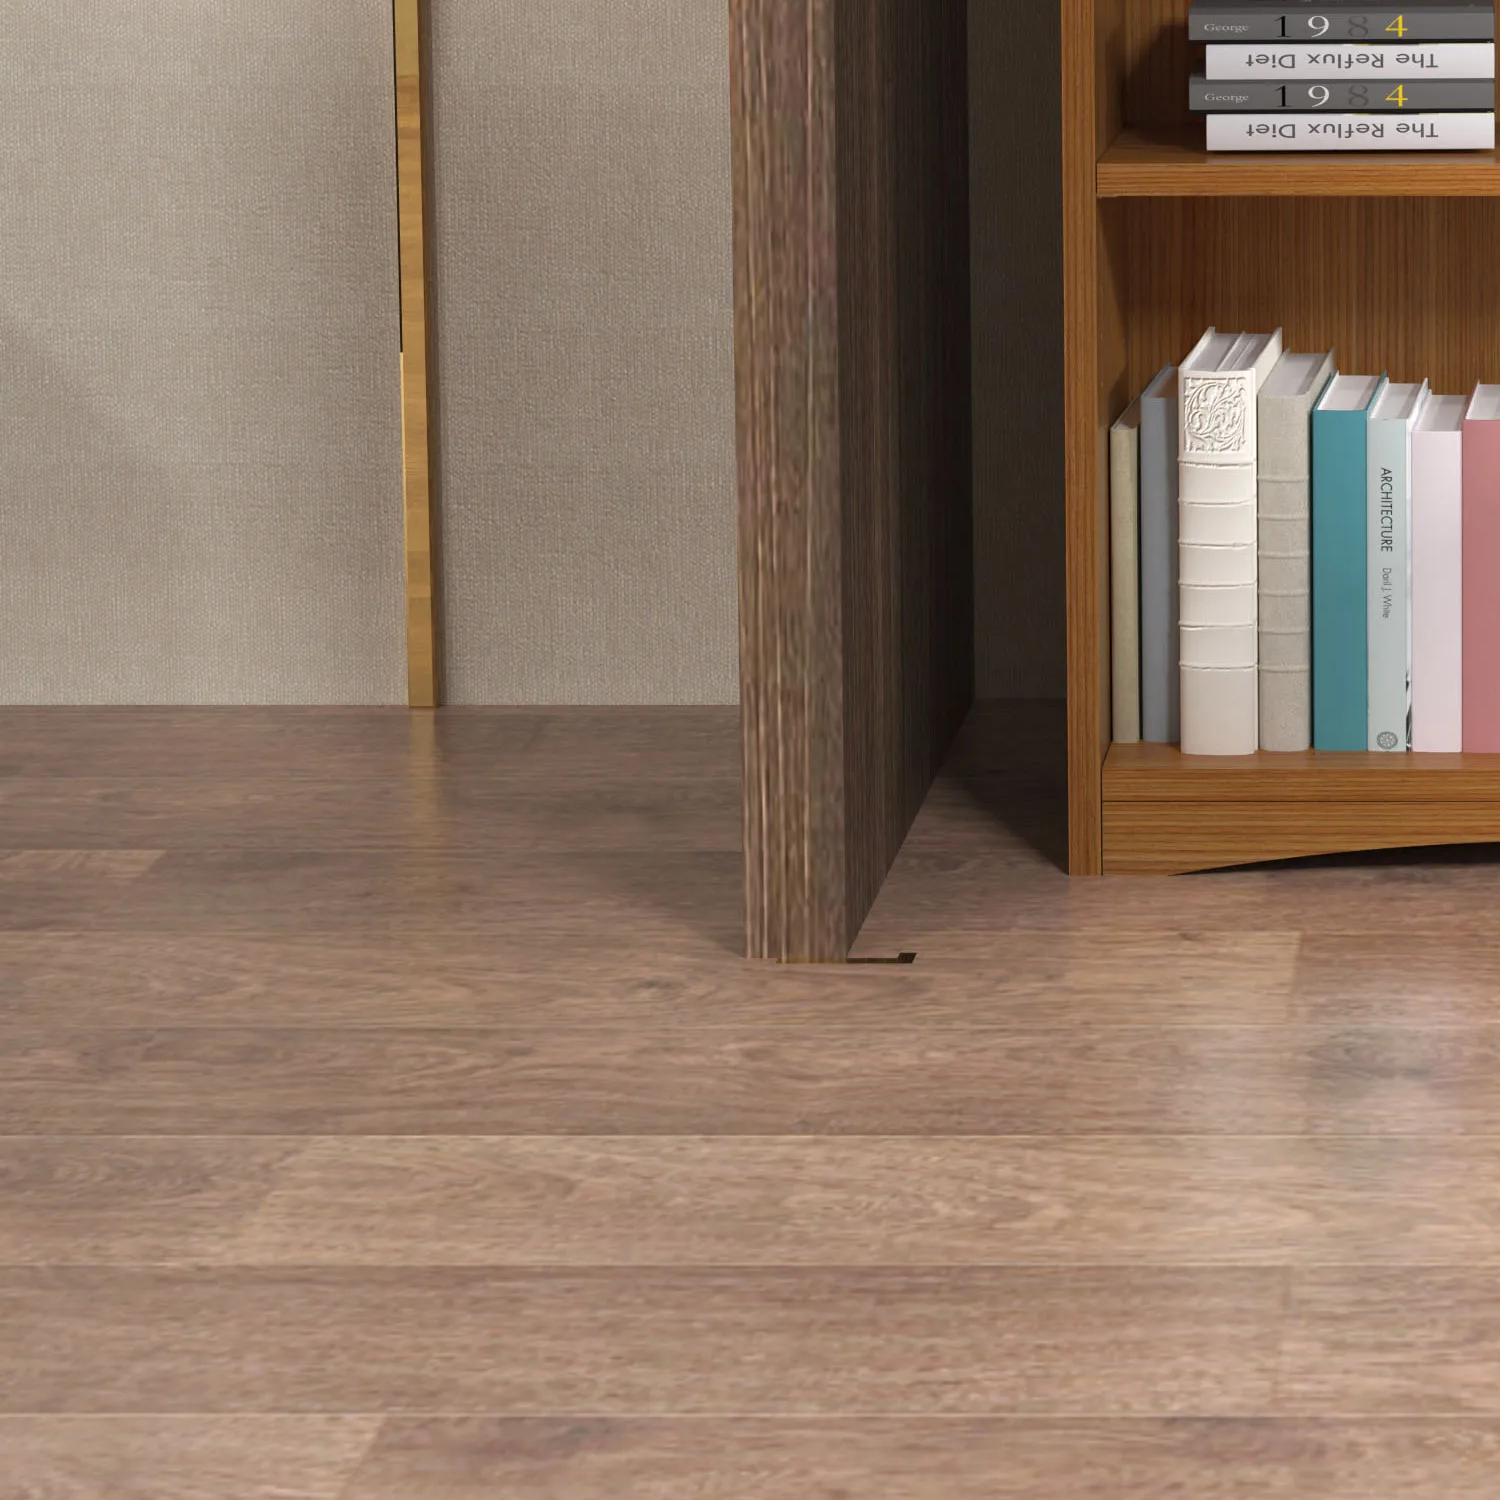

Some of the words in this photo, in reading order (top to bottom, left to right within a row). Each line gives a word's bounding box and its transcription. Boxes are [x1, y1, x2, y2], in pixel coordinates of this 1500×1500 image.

[1203, 23, 1249, 33] George
[1245, 53, 1296, 69] Diet
[1307, 53, 1384, 69] Reflux
[1395, 53, 1439, 69] The
[1203, 92, 1249, 103] George
[1245, 123, 1297, 139] Diet
[1307, 123, 1384, 139] Reflux
[1395, 123, 1439, 139] The
[1379, 466, 1393, 553] ARCHITECTURE
[1382, 594, 1393, 619] White
